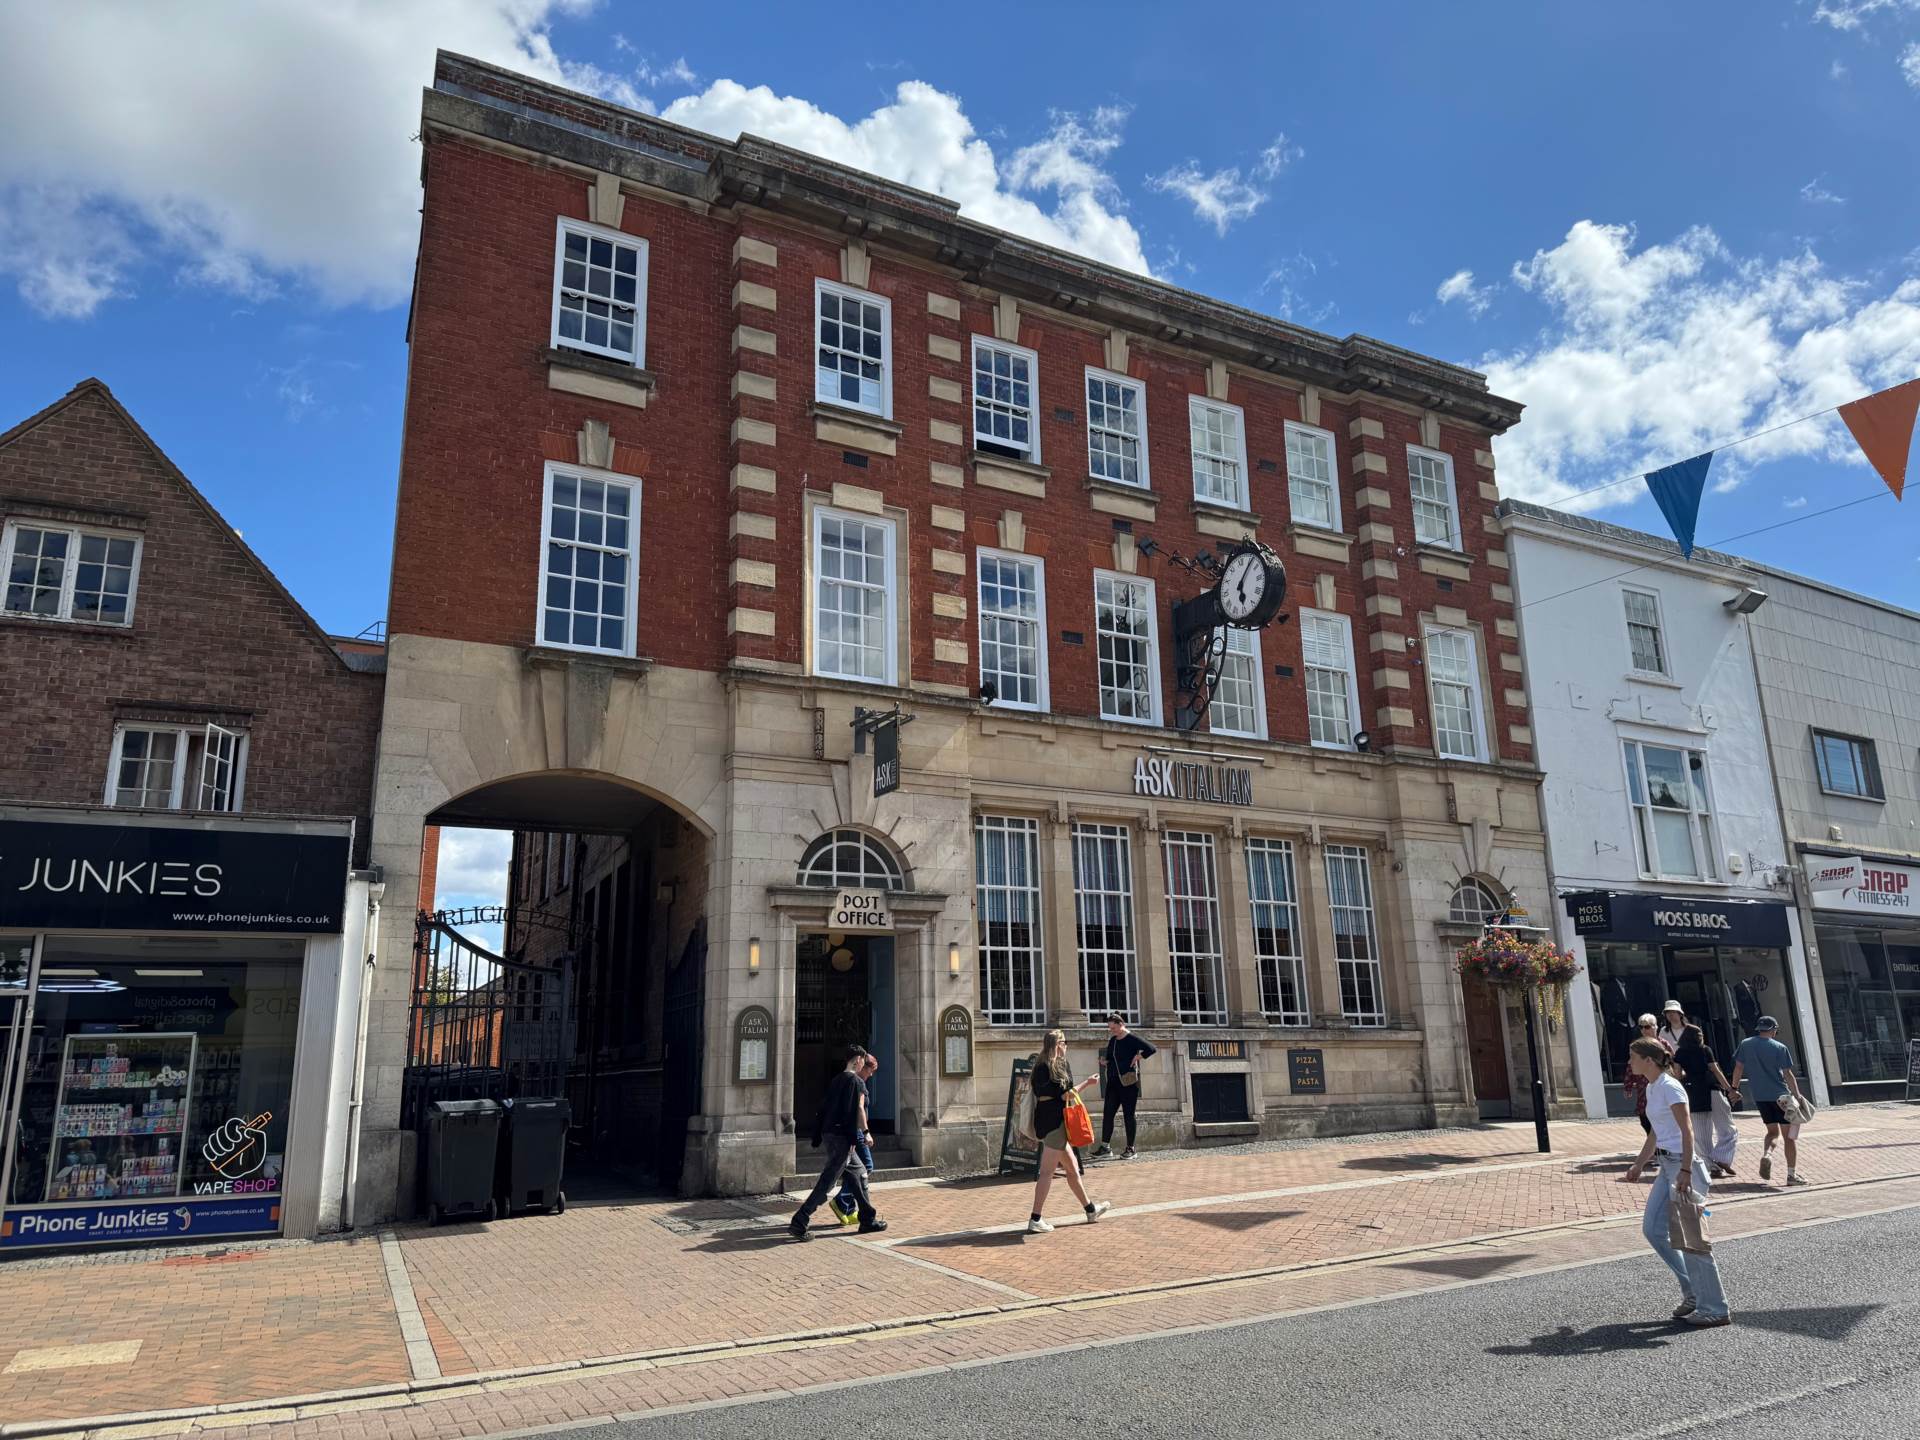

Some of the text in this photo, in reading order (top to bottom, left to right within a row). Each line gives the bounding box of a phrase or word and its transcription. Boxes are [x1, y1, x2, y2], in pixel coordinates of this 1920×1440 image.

[876, 761, 891, 790] ASK
[18, 857, 223, 897] JUNKIES
[844, 895, 879, 910] POST
[1578, 905, 1603, 915] MOSS
[172, 911, 330, 925] www.phonejunkies.co.uk
[837, 911, 886, 926] OFFICE
[1579, 914, 1606, 924] BROS.
[1652, 910, 1732, 930] MOSS BROS.
[748, 1018, 762, 1026] ASK
[945, 1023, 969, 1031] ITALIAN
[741, 1026, 768, 1034] ITALIAN
[1296, 1056, 1317, 1064] PIZZA
[1297, 1078, 1320, 1086] PASTA
[19, 1209, 169, 1234] Phone Junkies
